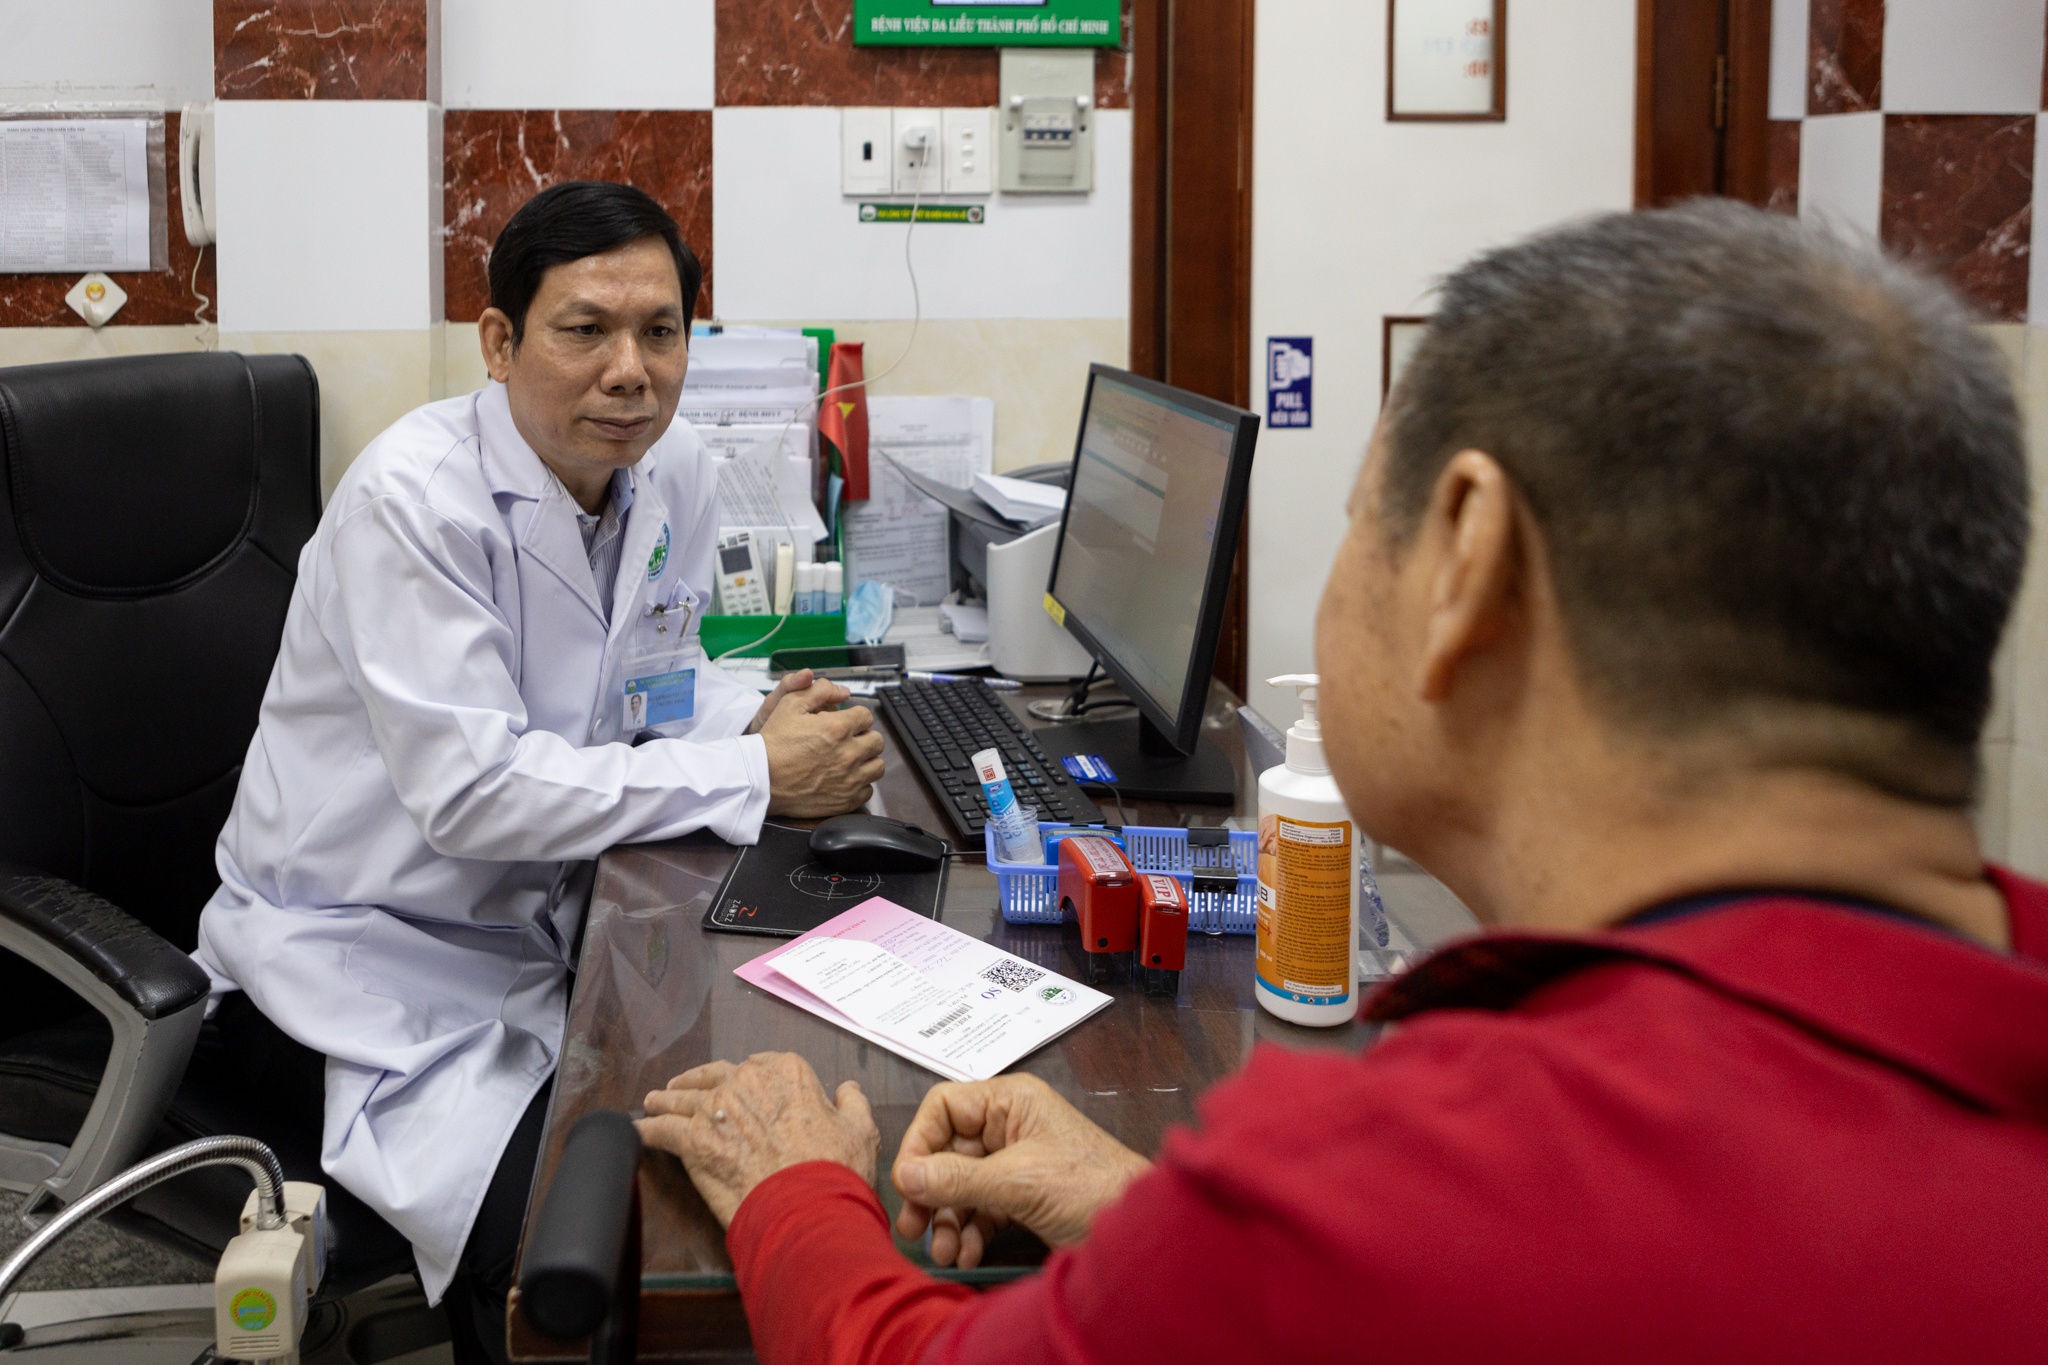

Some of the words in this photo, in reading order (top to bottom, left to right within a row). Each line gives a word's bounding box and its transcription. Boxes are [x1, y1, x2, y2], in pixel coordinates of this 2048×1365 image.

[872, 14, 901, 35] BỆNH
[904, 15, 930, 36] VIỆN
[933, 18, 947, 33] DA
[949, 13, 976, 33] LIỄU
[977, 15, 1013, 34] THÀNH
[1016, 14, 1040, 34] PHỐ
[1041, 13, 1057, 34] HỒ
[1059, 17, 1079, 34] CHÍ
[1080, 19, 1109, 35] MINH
[1276, 392, 1304, 409] PULL
[1153, 879, 1171, 900] VIP
[725, 900, 741, 924] ZADEZ
[981, 986, 1002, 1000] SỐ
[951, 1015, 973, 1027] PHIẾU
[939, 1027, 954, 1035] THU
